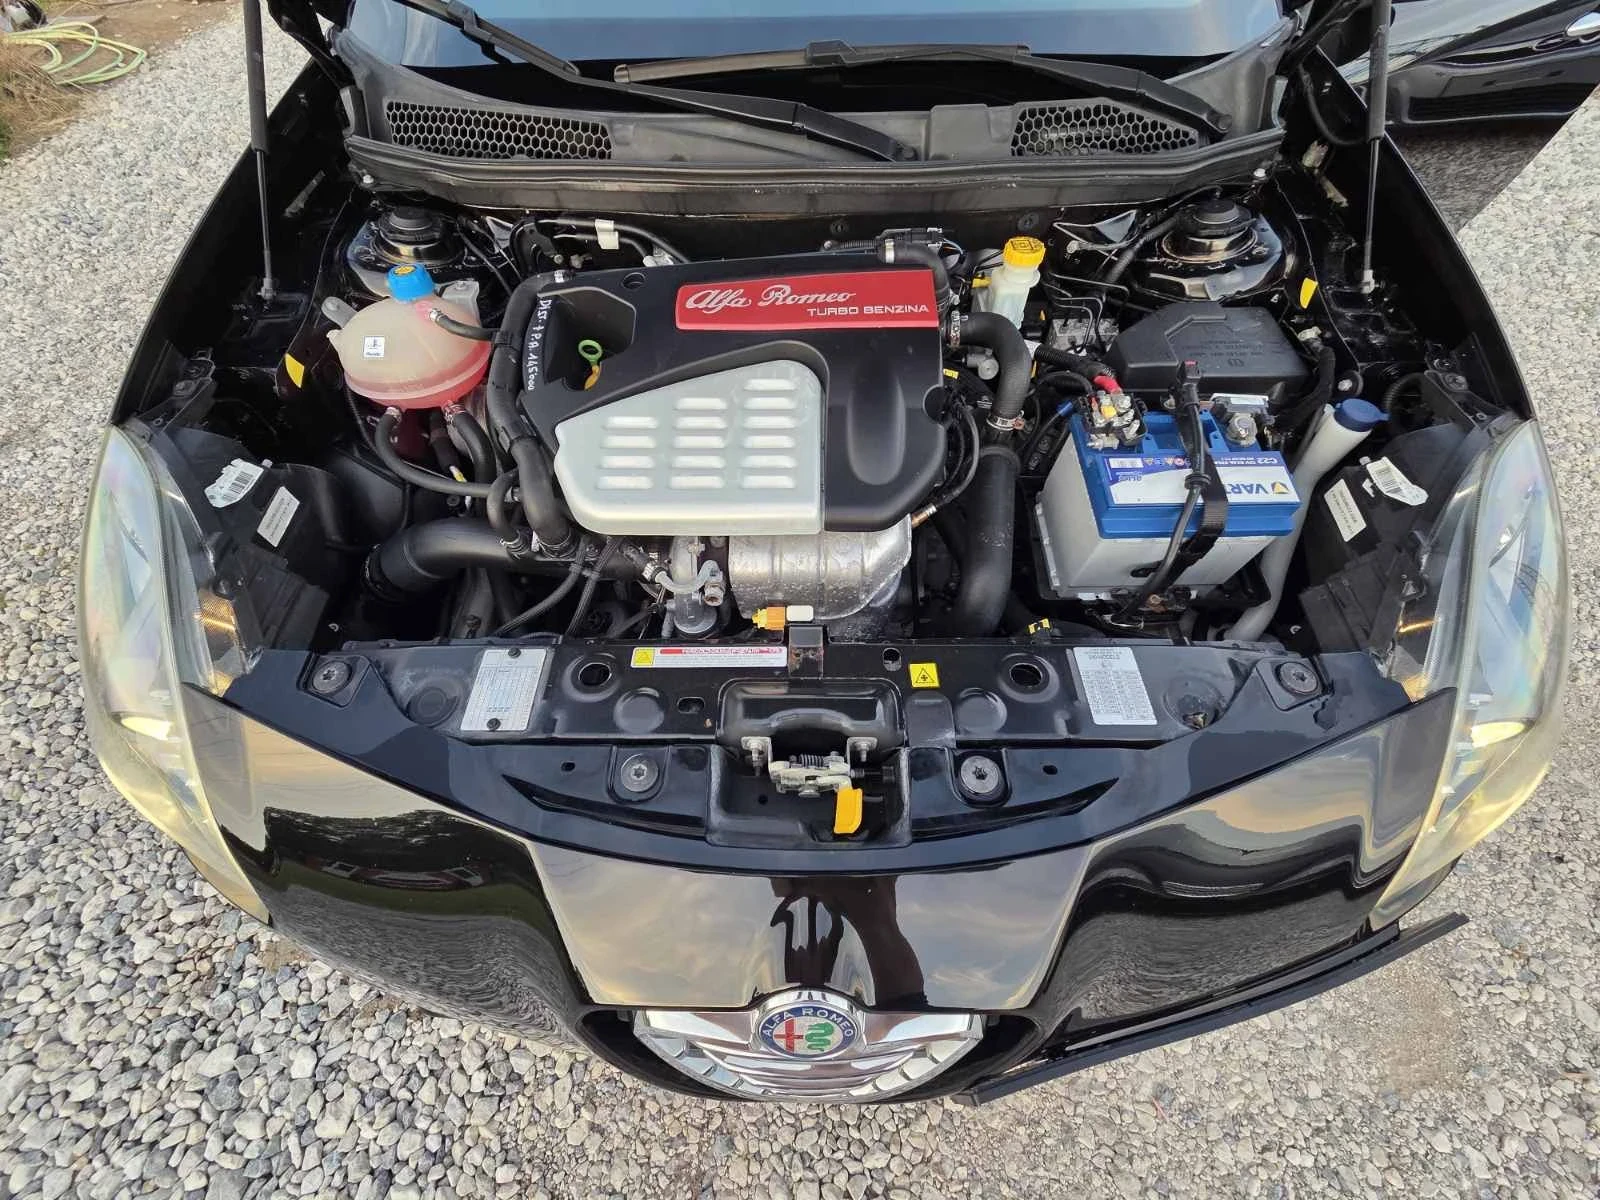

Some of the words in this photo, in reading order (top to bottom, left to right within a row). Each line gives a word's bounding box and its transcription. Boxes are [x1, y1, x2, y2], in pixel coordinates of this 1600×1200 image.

[685, 289, 752, 314] Alfa
[758, 284, 856, 307] Romeo
[806, 306, 859, 317] TURBO
[863, 304, 929, 315] BENZINA
[761, 1010, 795, 1038] ALFA
[801, 1007, 854, 1038] ROMEO
